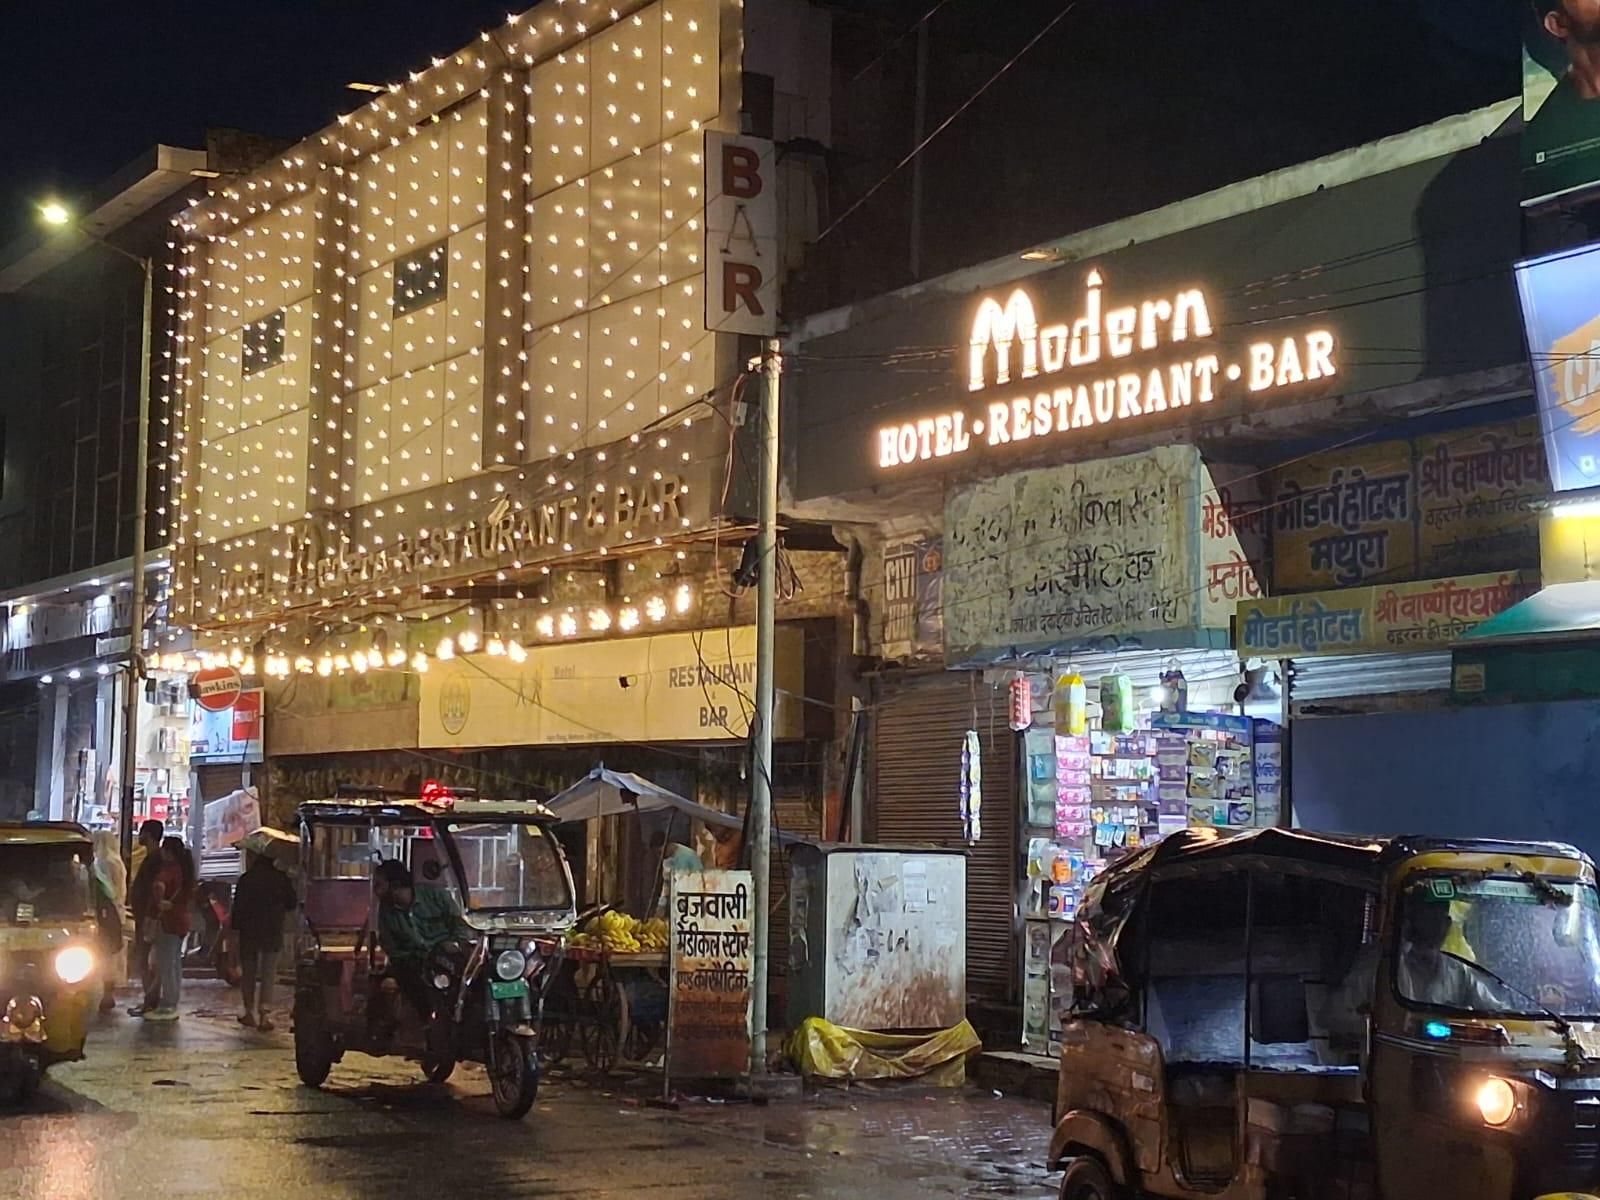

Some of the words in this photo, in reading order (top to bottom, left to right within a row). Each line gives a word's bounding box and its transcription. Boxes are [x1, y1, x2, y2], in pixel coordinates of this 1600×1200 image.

[722, 143, 765, 317] BAR
[967, 269, 1213, 392] Modern
[879, 411, 969, 468] HOTEL
[988, 356, 1219, 446] RESTAURANT
[1249, 330, 1337, 392] BAR
[398, 496, 577, 573] RESTAURANT
[584, 490, 605, 536] &
[613, 473, 682, 528] BAR
[1309, 529, 1390, 585] मथुरा
[1375, 589, 1398, 624] श्री
[198, 681, 241, 695] awkins
[669, 662, 756, 688] RESTAURAN
[700, 706, 728, 727] BAR
[677, 883, 747, 924] बृजवासी
[677, 922, 721, 957] मेडीकल
[722, 924, 750, 959] स्टोर
